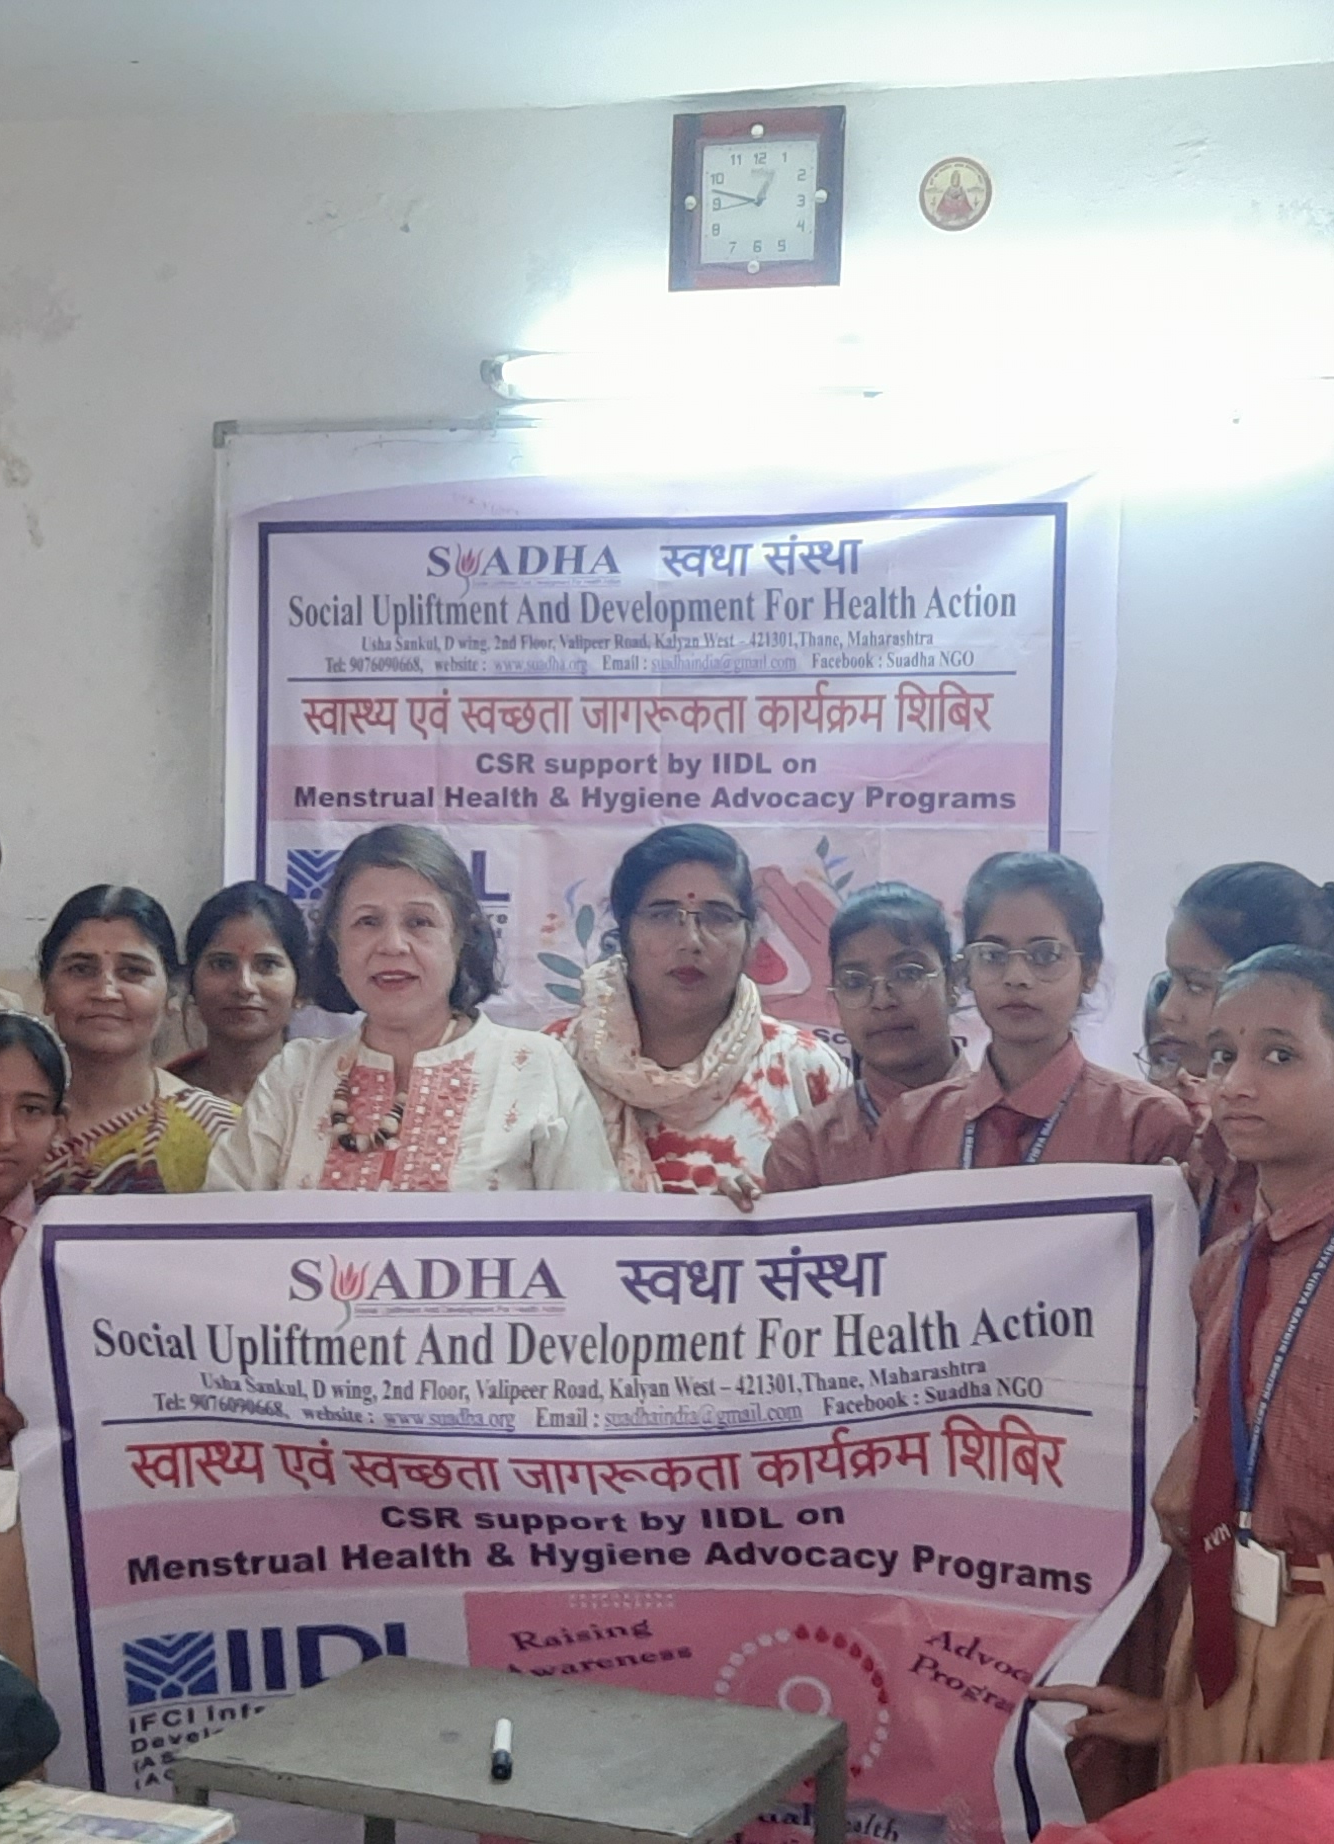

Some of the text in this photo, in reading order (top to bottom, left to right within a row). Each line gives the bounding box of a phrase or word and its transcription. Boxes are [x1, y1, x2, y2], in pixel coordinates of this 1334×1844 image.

[731, 154, 741, 165] 11
[754, 152, 767, 164] 12
[782, 152, 787, 162] 1
[710, 172, 724, 185] 10
[797, 169, 806, 181] 2
[797, 195, 805, 207] 3
[712, 223, 720, 236] 8
[796, 220, 805, 232] 4
[729, 241, 737, 254] 7
[753, 240, 762, 252] 6
[778, 240, 786, 252] 5
[659, 534, 863, 577] स्वधा संस्था
[289, 584, 1016, 635] Social Upliftment And Development For Health Action
[361, 636, 391, 651] Usha
[444, 635, 454, 650] D
[494, 635, 516, 650] 2nd
[520, 634, 556, 652] Floor,
[559, 633, 610, 652] Valipeer
[614, 633, 651, 650] Road,
[654, 633, 699, 652] Kalyan
[703, 632, 734, 648] West
[847, 630, 934, 647] Maharashtra
[434, 657, 479, 672] website
[602, 655, 639, 671] Email
[812, 653, 874, 669] Facebook
[886, 652, 935, 667] Suadha
[939, 650, 974, 667] NGO
[301, 680, 994, 740] स्वास्थ्य एवं स्वच्छता जागरूकता कार्यक्रम शिबिर
[476, 752, 817, 779] CSR support by IIDL on
[294, 786, 1016, 813] Menstrual Health & Hygiene Advocacy Programs
[616, 1245, 888, 1305] स्वधा संस्था
[93, 1301, 1094, 1376] Social Upliftment And Development For Health Action
[200, 1371, 241, 1392] Usha
[246, 1377, 308, 1400] Sankul,
[313, 1379, 326, 1399] D
[331, 1379, 378, 1405] wing,
[383, 1379, 414, 1400] 2nd
[420, 1379, 470, 1402] Floor,
[476, 1379, 549, 1404] Valipeer
[554, 1378, 604, 1401] Road,
[610, 1377, 668, 1404] Kalyan
[675, 1376, 716, 1397] West
[869, 1360, 986, 1387] Maharashtra
[301, 1405, 363, 1423] website
[536, 1407, 588, 1428] Email
[823, 1392, 909, 1417] Facebook
[924, 1380, 992, 1404] Suadha
[996, 1377, 1043, 1399] NGO
[126, 1414, 1067, 1495] स्वास्थ्य एवं स्वच्छता जागरूकता कार्यक्रम शिबिर
[381, 1505, 845, 1535] CSR support by IIDL on
[127, 1541, 1092, 1596] Menstrual Health & Hygiene Advocacy Programs
[510, 1619, 653, 1650] Raising
[924, 1630, 1034, 1685] Advoca
[908, 1653, 1016, 1713] Progra
[129, 1707, 195, 1734] IFCI
[131, 1728, 223, 1753] Devel
